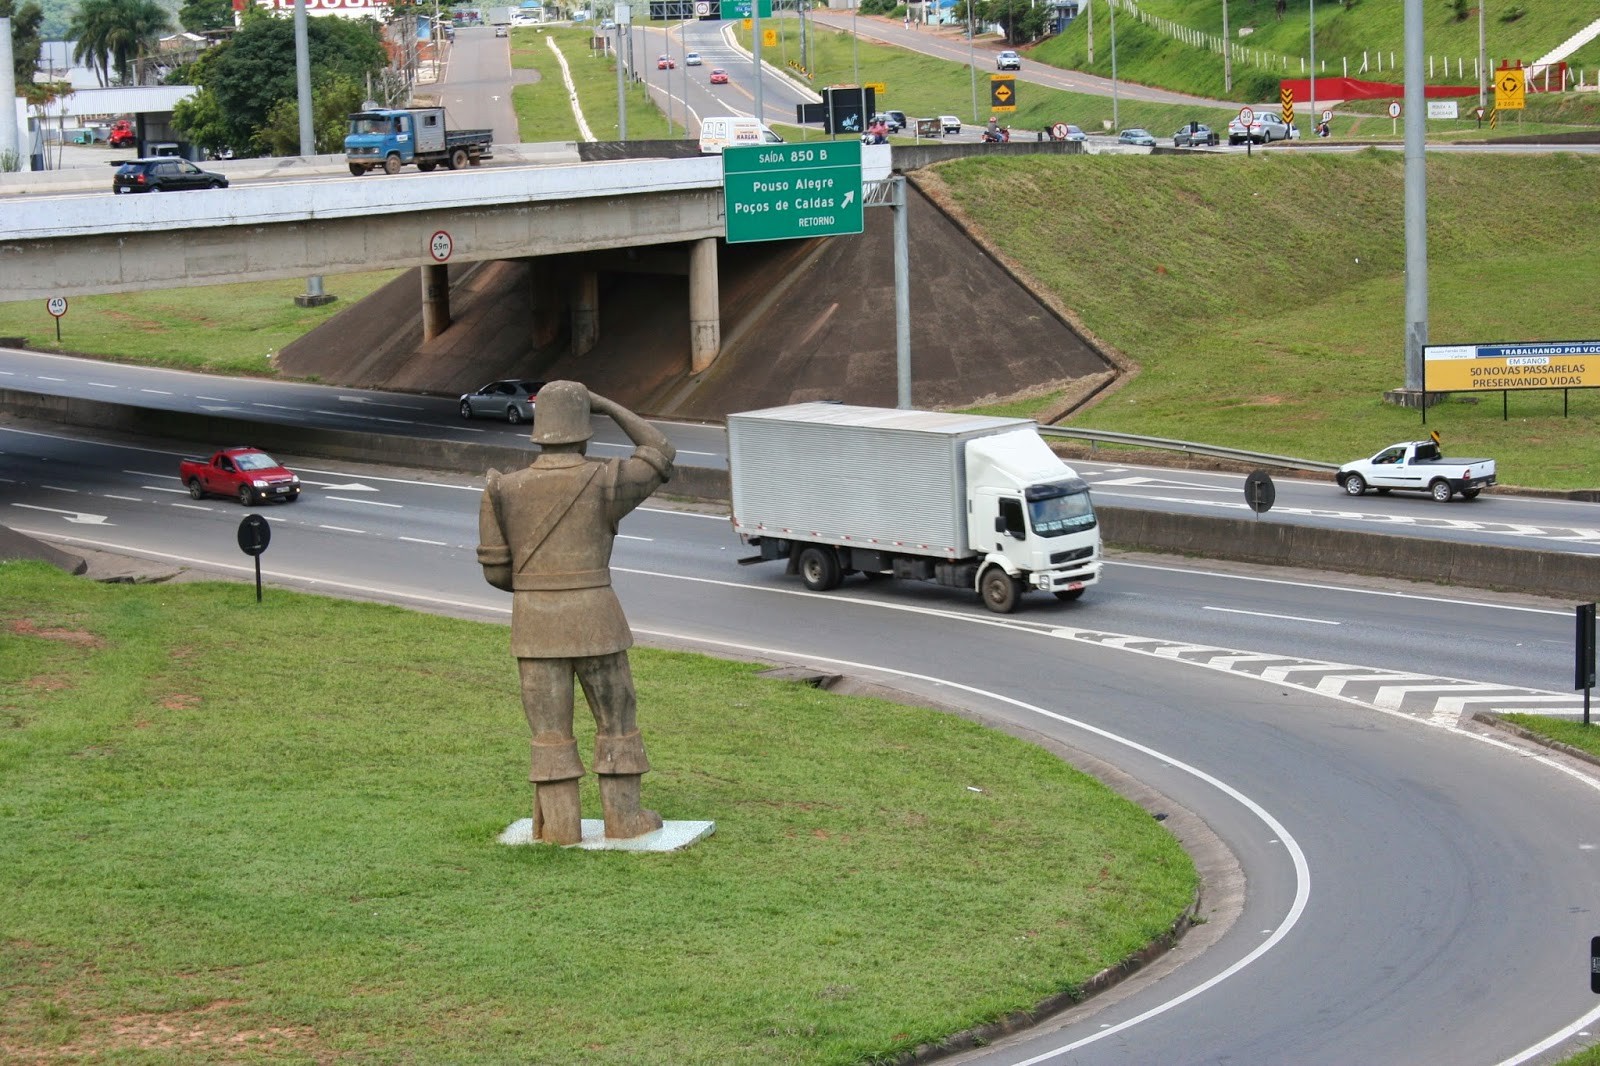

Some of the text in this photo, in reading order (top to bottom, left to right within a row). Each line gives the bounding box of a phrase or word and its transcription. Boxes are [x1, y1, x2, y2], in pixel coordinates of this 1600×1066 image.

[759, 150, 828, 164] SAÍDA 850 B
[753, 178, 834, 193] Pouso Alegre
[735, 197, 834, 215] Poços de Caldas
[798, 215, 835, 227] RETORNO
[52, 299, 63, 307] 40
[1500, 348, 1562, 356] TRABALHANDO
[1470, 364, 1586, 376] 50 NOVAS PASSARELAS
[1472, 376, 1582, 387] PRESERVANDO VIDAS
